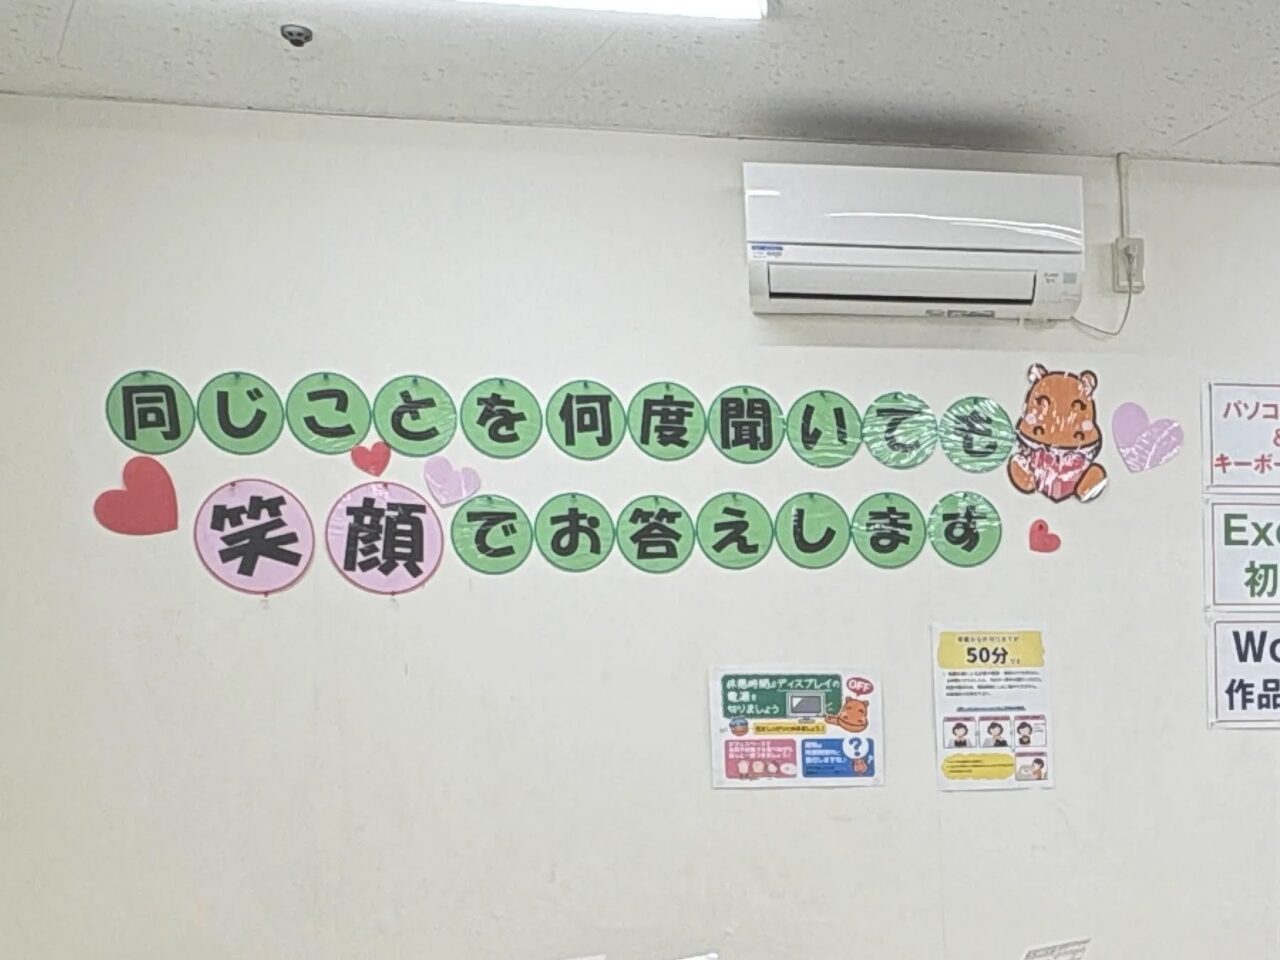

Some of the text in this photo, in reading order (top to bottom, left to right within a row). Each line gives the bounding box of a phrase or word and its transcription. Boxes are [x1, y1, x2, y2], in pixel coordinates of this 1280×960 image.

[122, 385, 996, 457] 同じことを何度聞いても
[210, 495, 987, 578] 笑顔でお答えします
[848, 681, 872, 691] OFF
